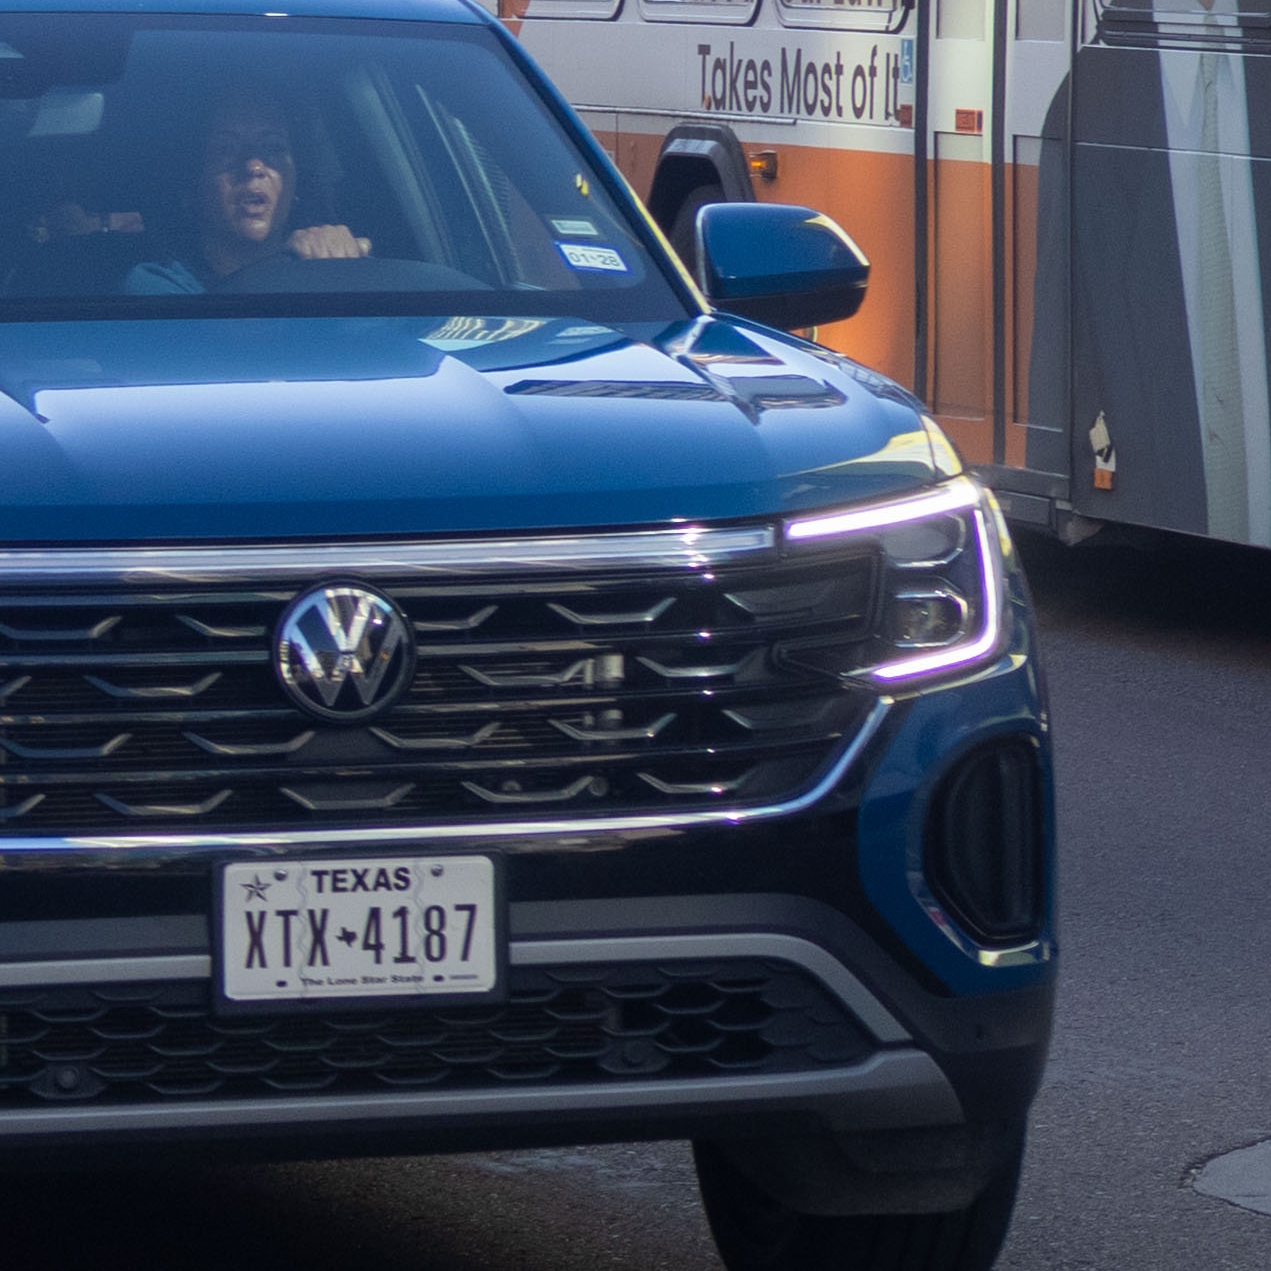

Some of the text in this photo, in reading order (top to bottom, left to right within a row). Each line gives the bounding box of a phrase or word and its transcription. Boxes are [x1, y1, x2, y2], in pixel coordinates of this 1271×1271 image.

[698, 41, 773, 113] Takes
[780, 47, 845, 117] Most
[851, 44, 878, 120] of
[311, 867, 412, 894] TEXAS
